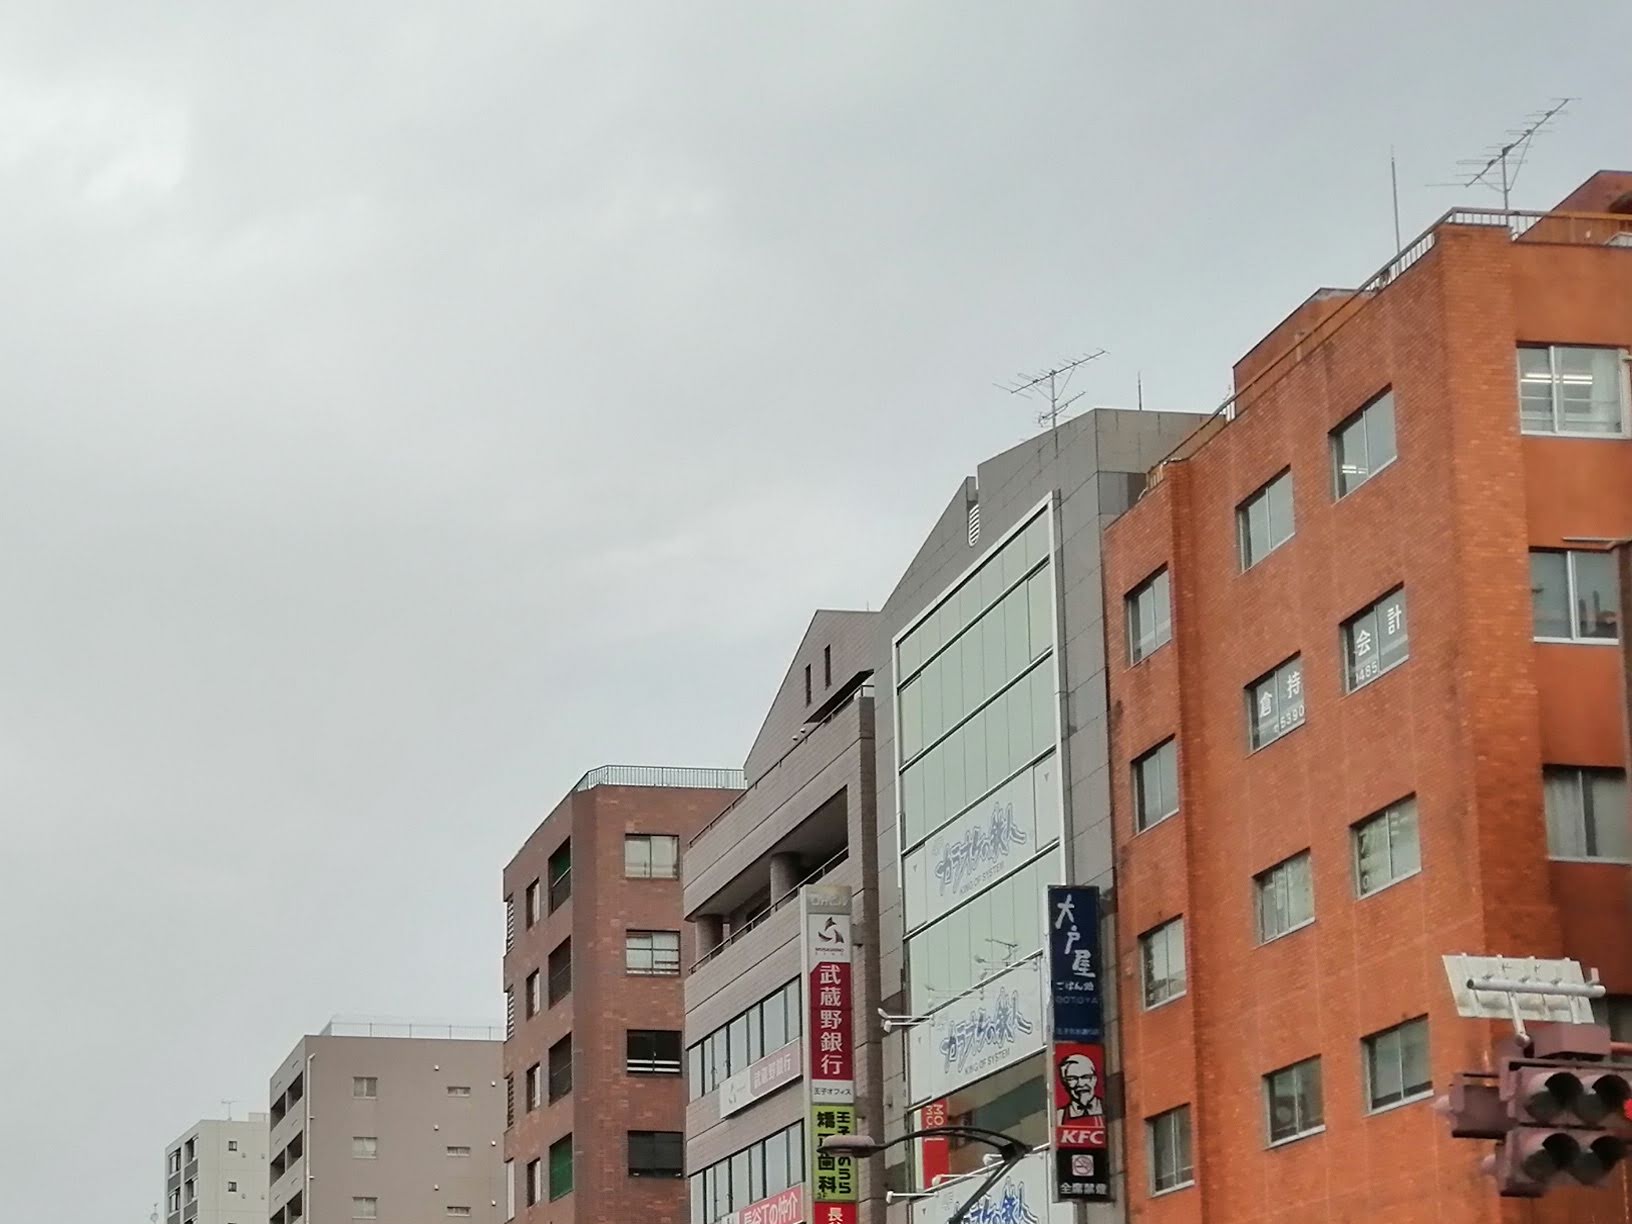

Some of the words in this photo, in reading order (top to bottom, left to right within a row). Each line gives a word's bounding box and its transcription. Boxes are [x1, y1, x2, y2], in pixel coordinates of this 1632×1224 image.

[1055, 894, 1096, 978] 大戸屋
[820, 964, 842, 1076] 武蔵野銀行
[987, 1047, 1011, 1066] SYSTEM
[814, 1087, 852, 1096] 王子オフィス
[837, 1111, 851, 1194] 王子のうら
[1060, 1129, 1105, 1145] KFC
